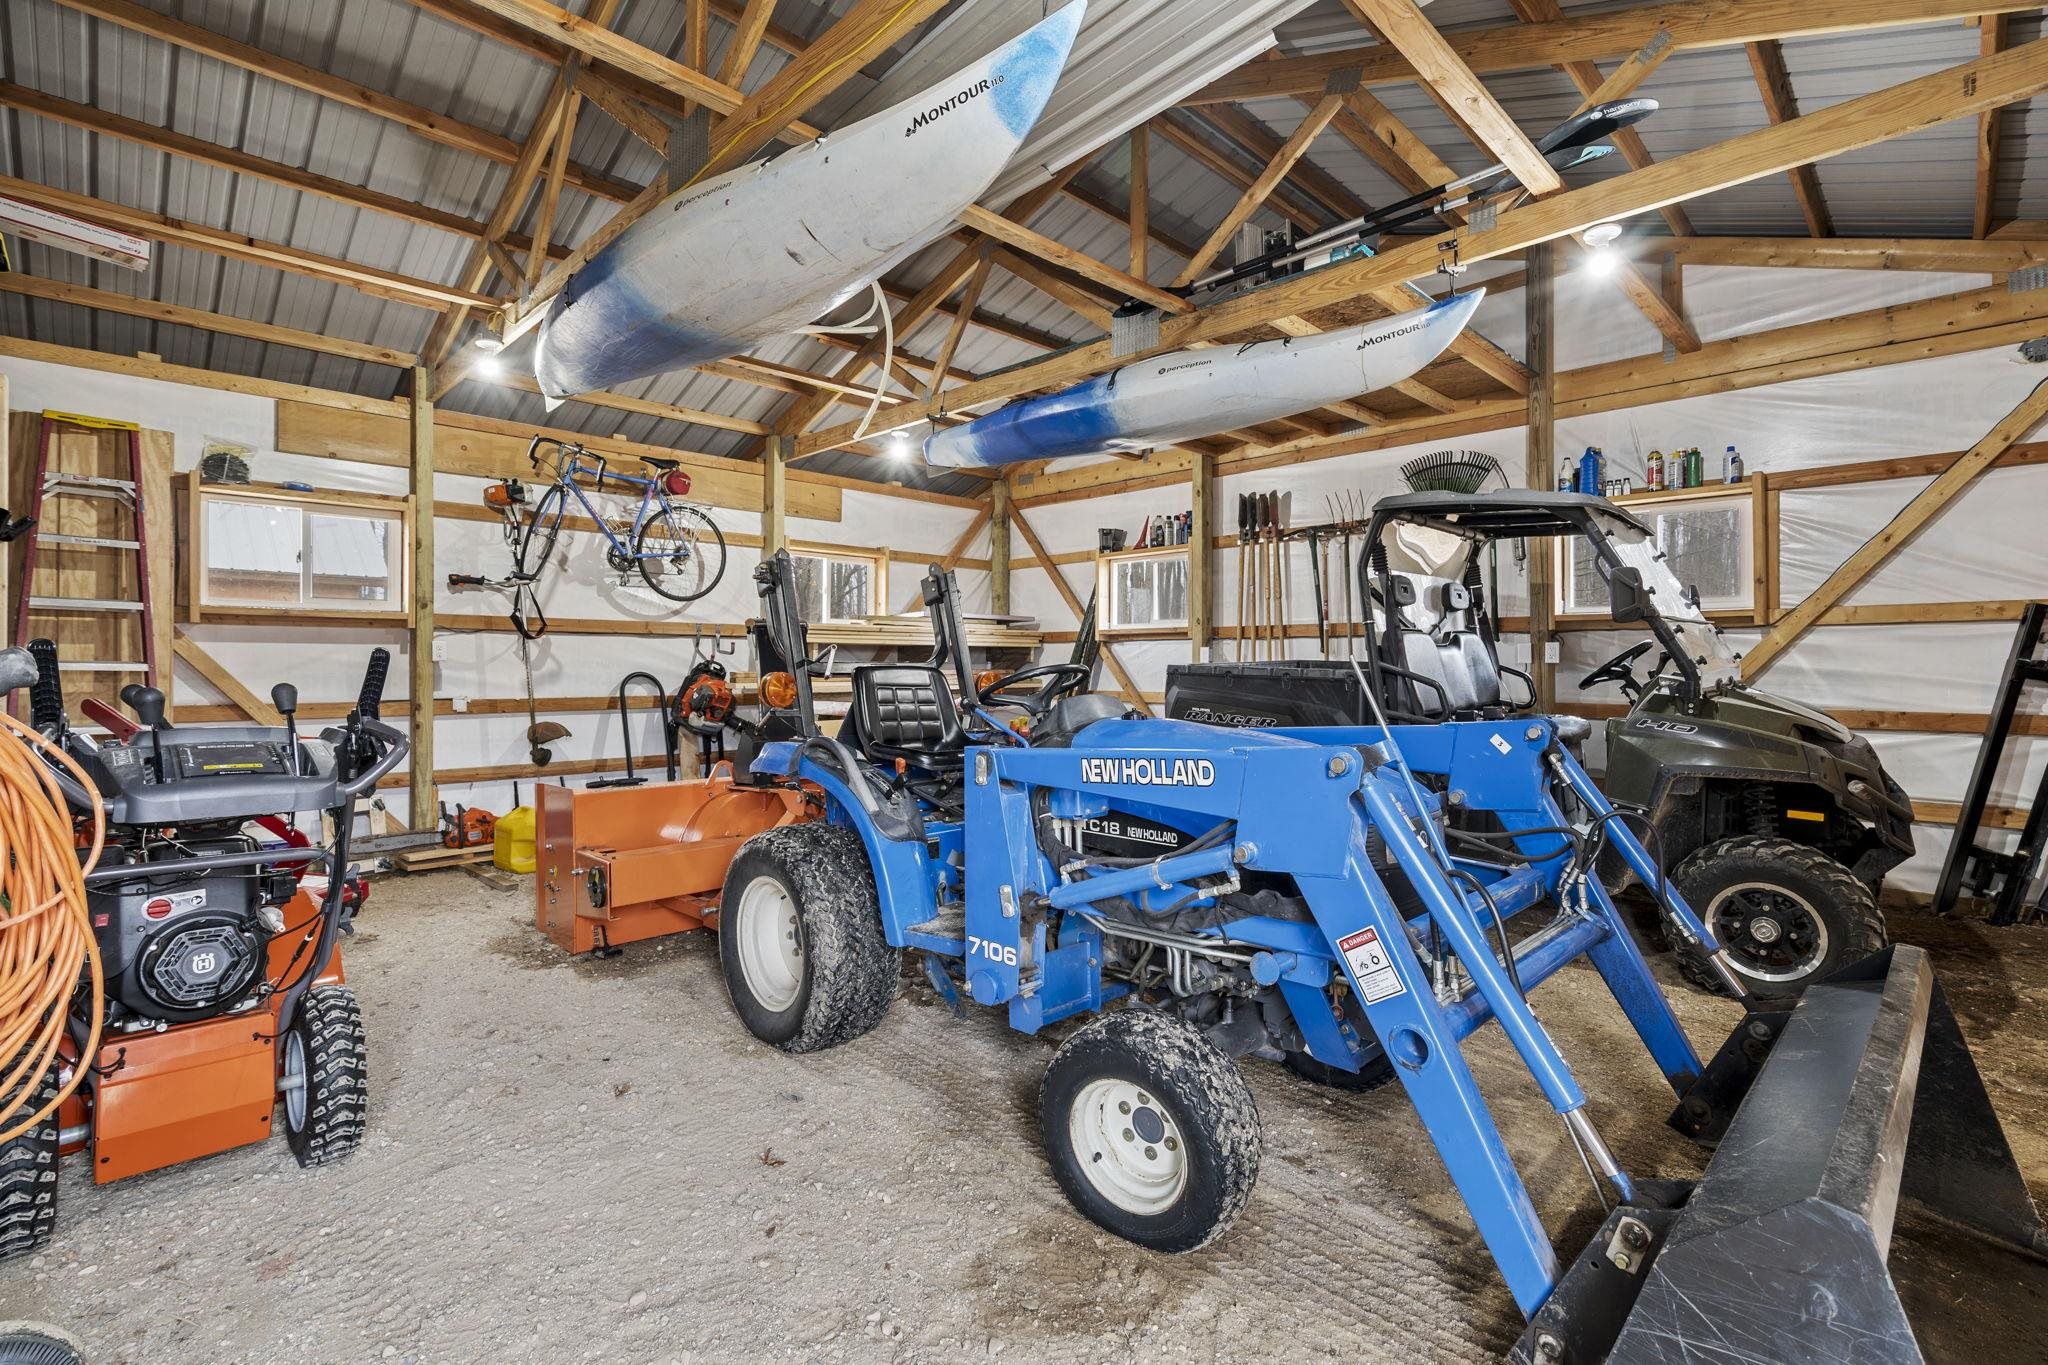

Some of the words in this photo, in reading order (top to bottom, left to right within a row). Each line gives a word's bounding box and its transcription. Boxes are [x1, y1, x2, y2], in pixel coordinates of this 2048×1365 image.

[1603, 101, 1641, 114] harmony
[1167, 360, 1212, 373] perception
[1184, 710, 1277, 728] RANGER
[1636, 719, 1698, 734] HD
[1081, 757, 1119, 784] NEW
[1121, 758, 1215, 787] HOLLAND
[1127, 826, 1143, 838] NEW
[1144, 829, 1178, 843] HOLLAND
[1348, 932, 1373, 946] DANGER
[968, 935, 1017, 967] 7106
